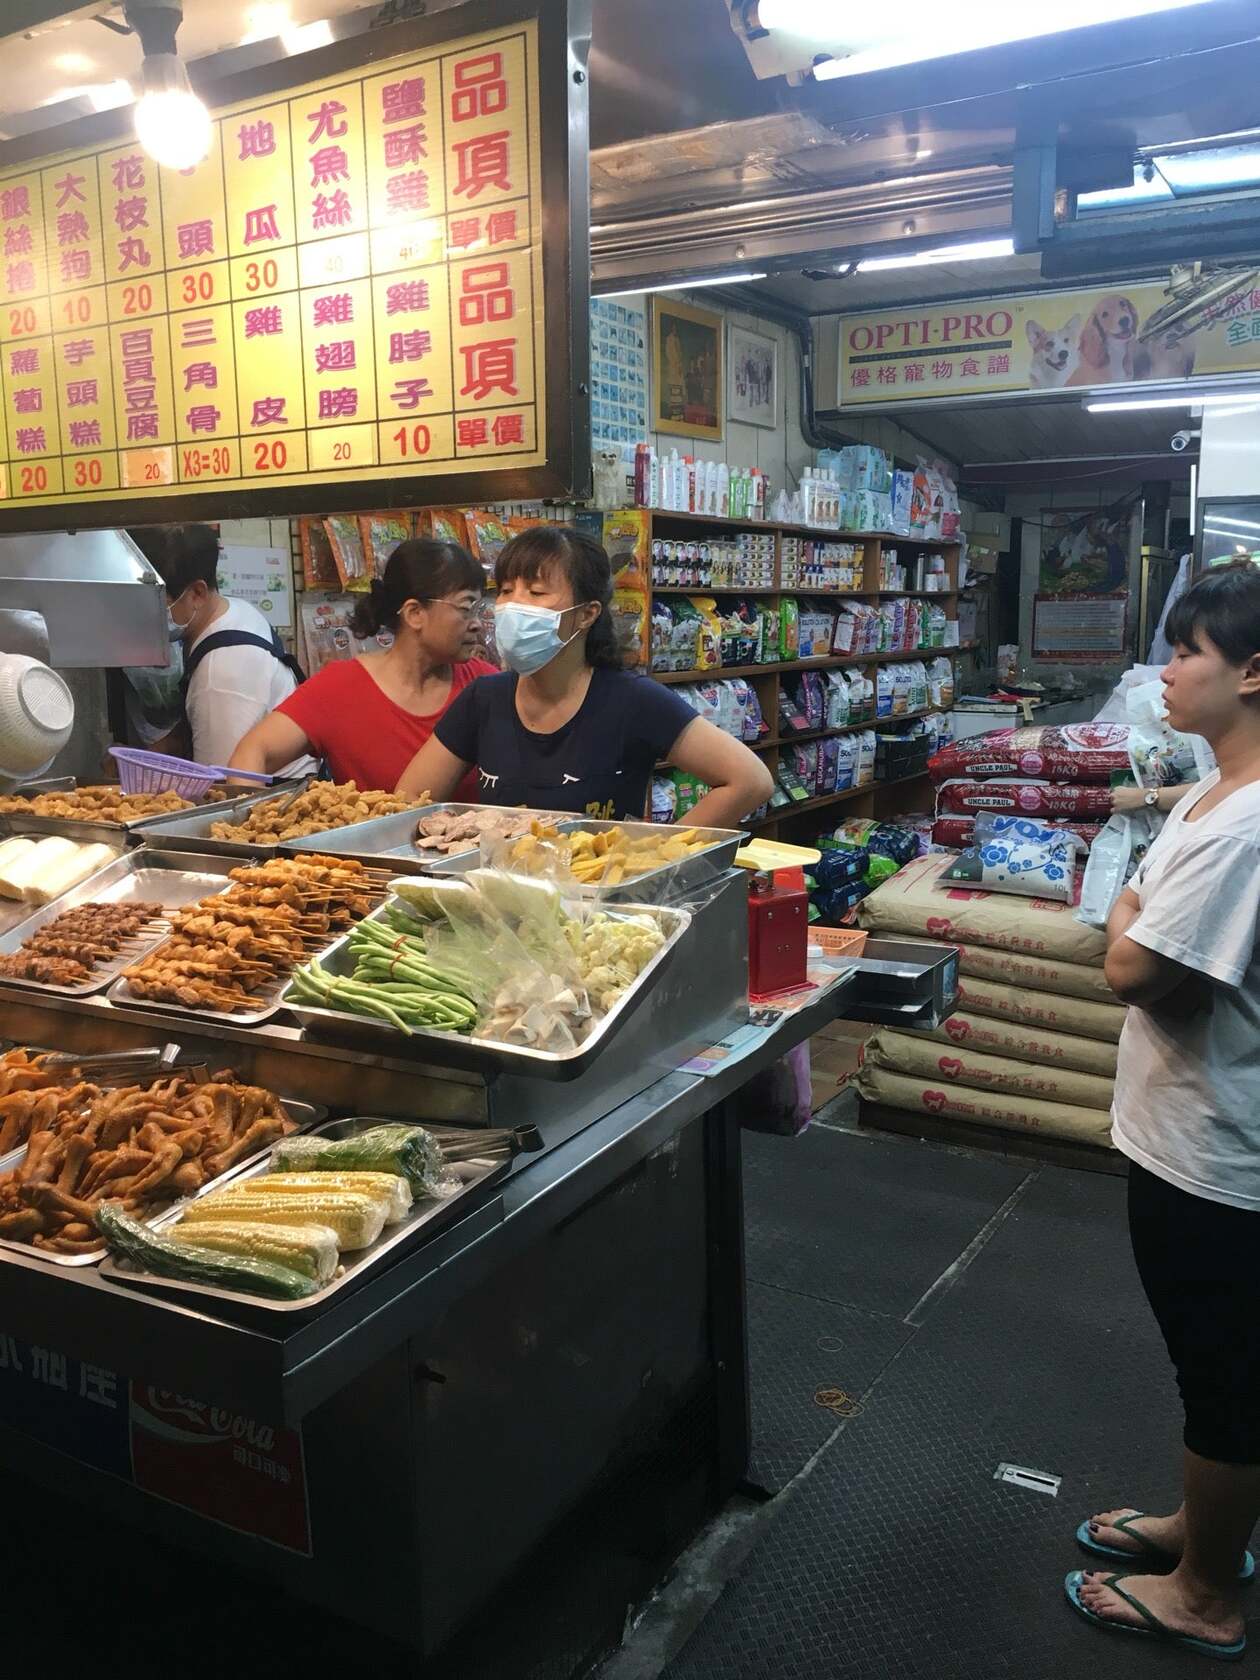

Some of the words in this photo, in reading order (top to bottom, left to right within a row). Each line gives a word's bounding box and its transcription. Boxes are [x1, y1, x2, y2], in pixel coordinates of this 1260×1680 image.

[451, 52, 512, 199] 品項
[382, 77, 430, 215] 鹽酥雞
[307, 101, 351, 230] 尤魚絲
[239, 120, 281, 246] 地瓜
[54, 173, 91, 282] 大熱狗
[111, 155, 151, 272] 花枝丸
[450, 209, 517, 247] 單價
[182, 271, 214, 303] 30
[245, 259, 278, 291] 30
[64, 297, 91, 323] 10
[123, 284, 152, 314] 20
[9, 307, 36, 335] 20
[459, 262, 518, 400] 品項
[313, 293, 358, 419] 雞翅膀
[386, 279, 433, 409] 雞脖子
[181, 319, 220, 433] 三角骨
[245, 305, 288, 426] 雞皮
[850, 354, 1010, 387] 優格寵物食譜
[10, 349, 46, 453] 蘿蔔糕
[64, 340, 101, 447] 芋頭糕
[120, 328, 158, 440] 百頁豆腐
[394, 424, 431, 457] 10
[457, 414, 524, 448] 單價
[183, 447, 230, 478] X3=30
[254, 440, 288, 470] 20
[333, 442, 352, 461] 20
[21, 465, 47, 492] 20
[75, 459, 102, 486] 30
[144, 463, 161, 480] 20
[970, 764, 993, 772] UNCLE
[967, 798, 991, 806] UNCLE
[992, 798, 1011, 806] PAUL
